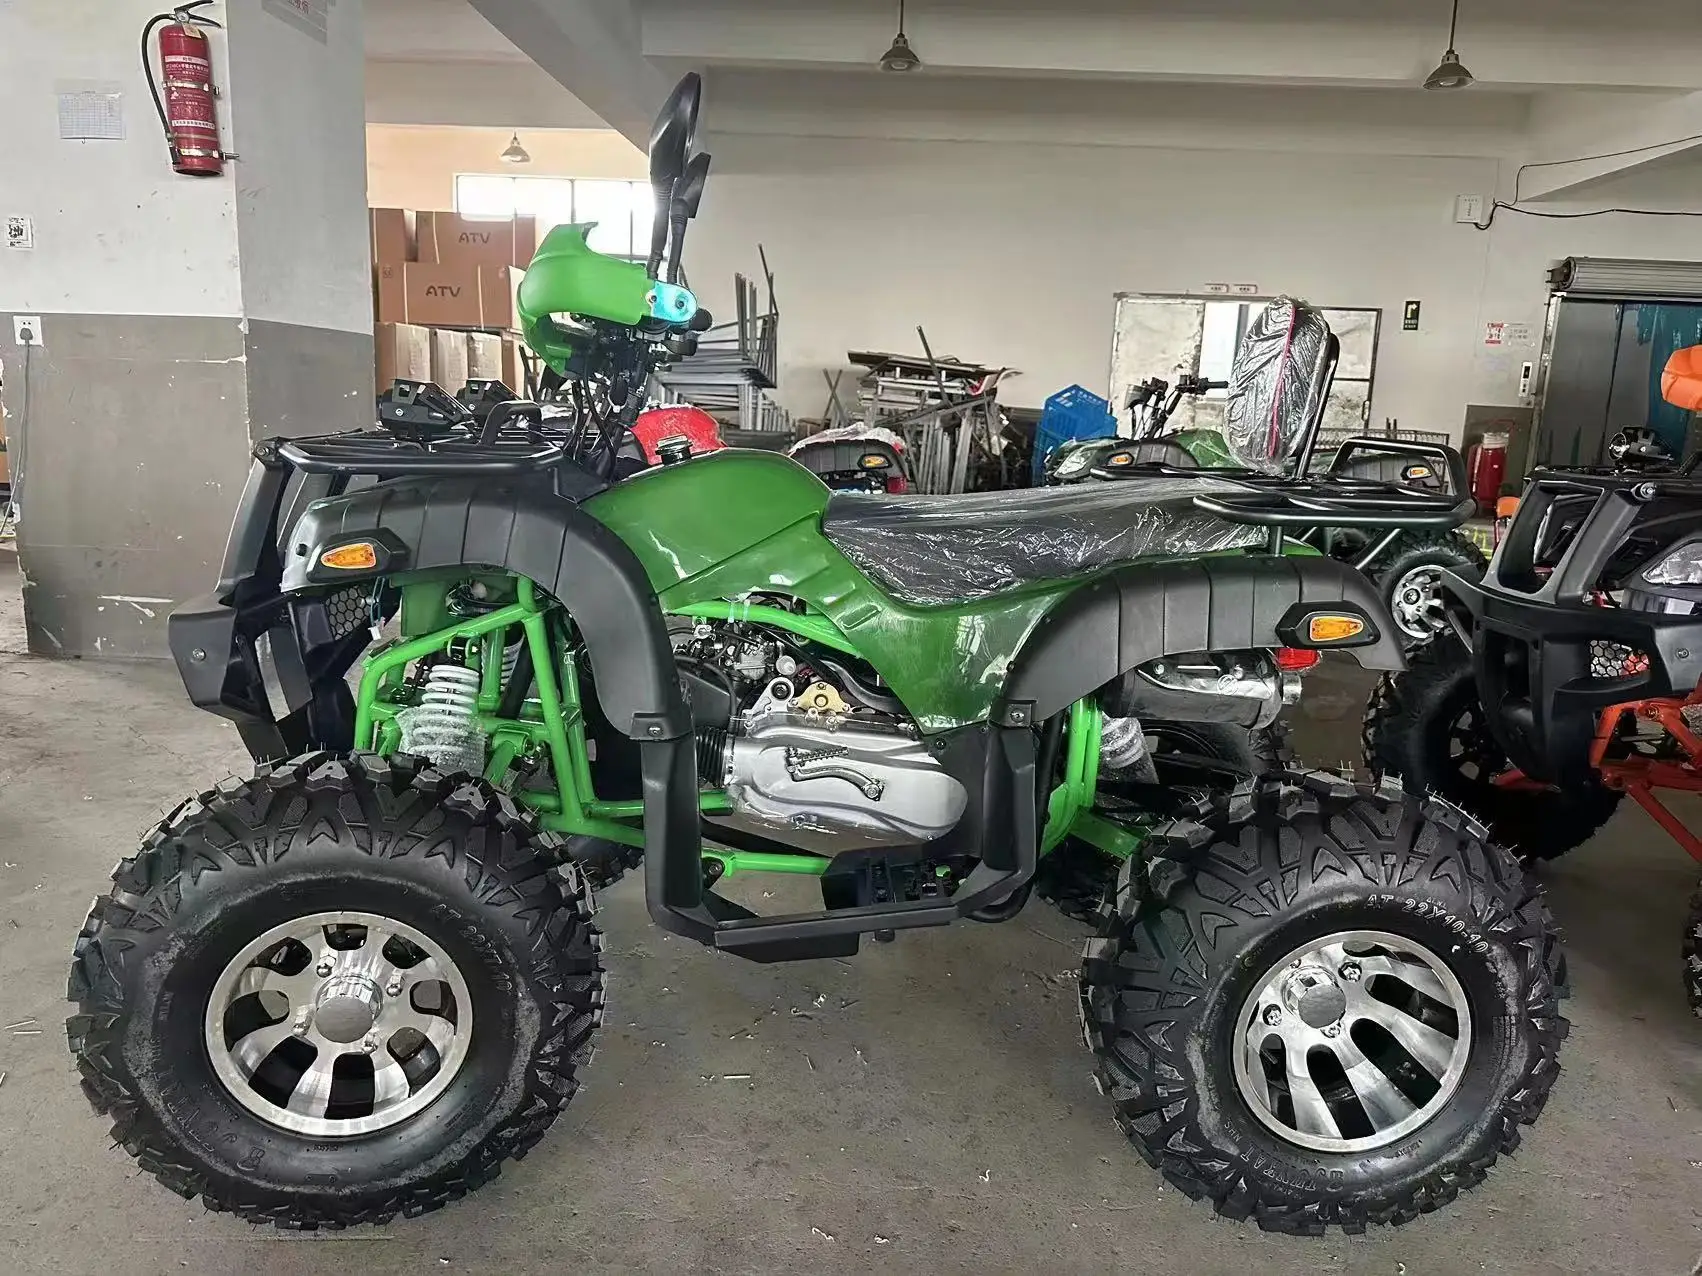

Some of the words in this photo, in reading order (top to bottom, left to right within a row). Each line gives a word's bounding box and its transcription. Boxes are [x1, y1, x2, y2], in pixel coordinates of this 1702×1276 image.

[459, 232, 491, 244] ATV
[425, 285, 461, 298] ATV
[1366, 894, 1395, 907] AT
